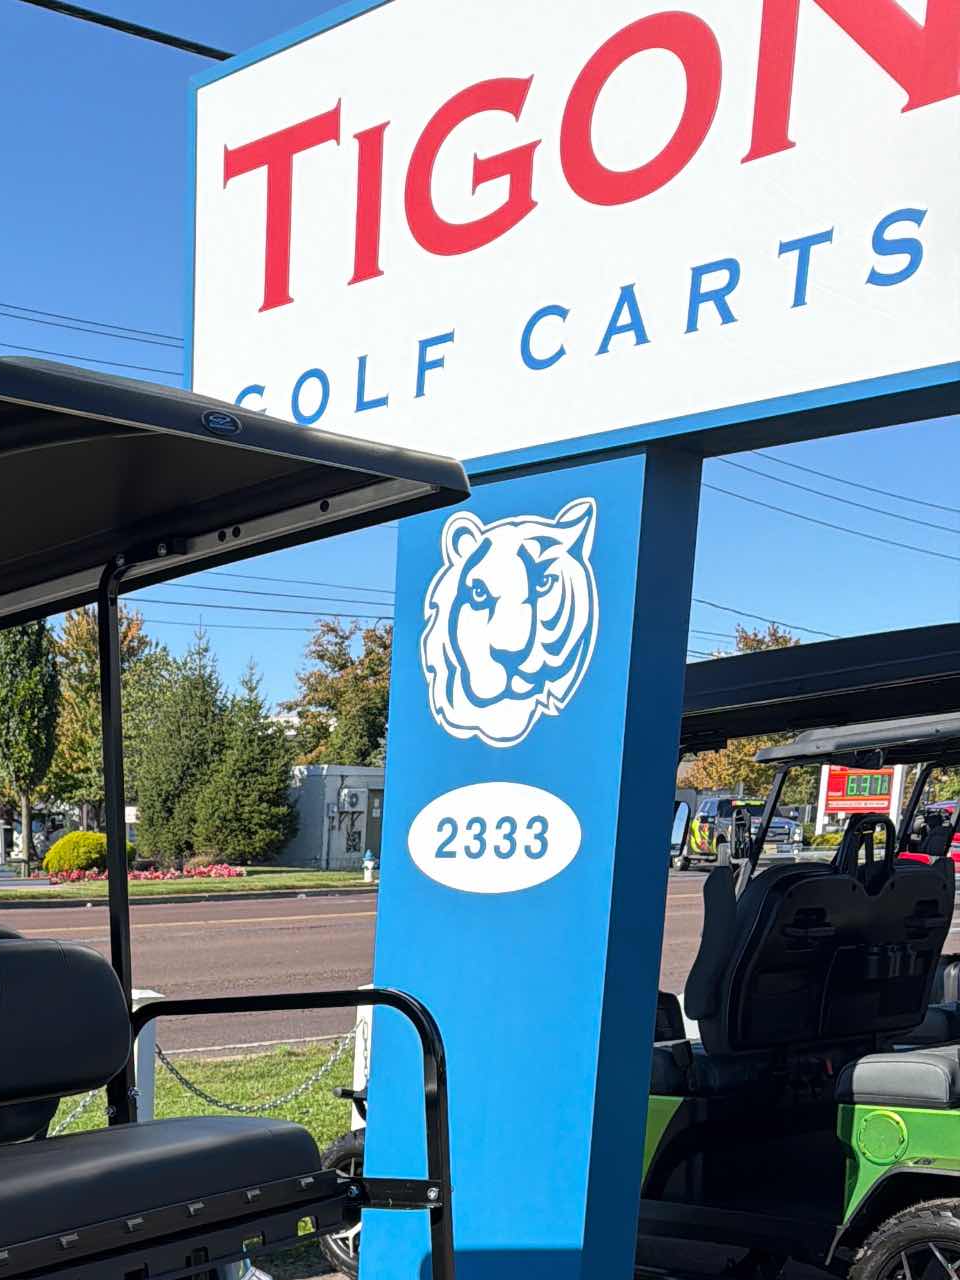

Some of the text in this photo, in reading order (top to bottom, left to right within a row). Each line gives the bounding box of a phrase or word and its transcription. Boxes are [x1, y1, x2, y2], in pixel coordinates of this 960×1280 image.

[223, 0, 960, 313] TIGON
[520, 207, 927, 371] CARTS
[434, 815, 549, 860] 2333
